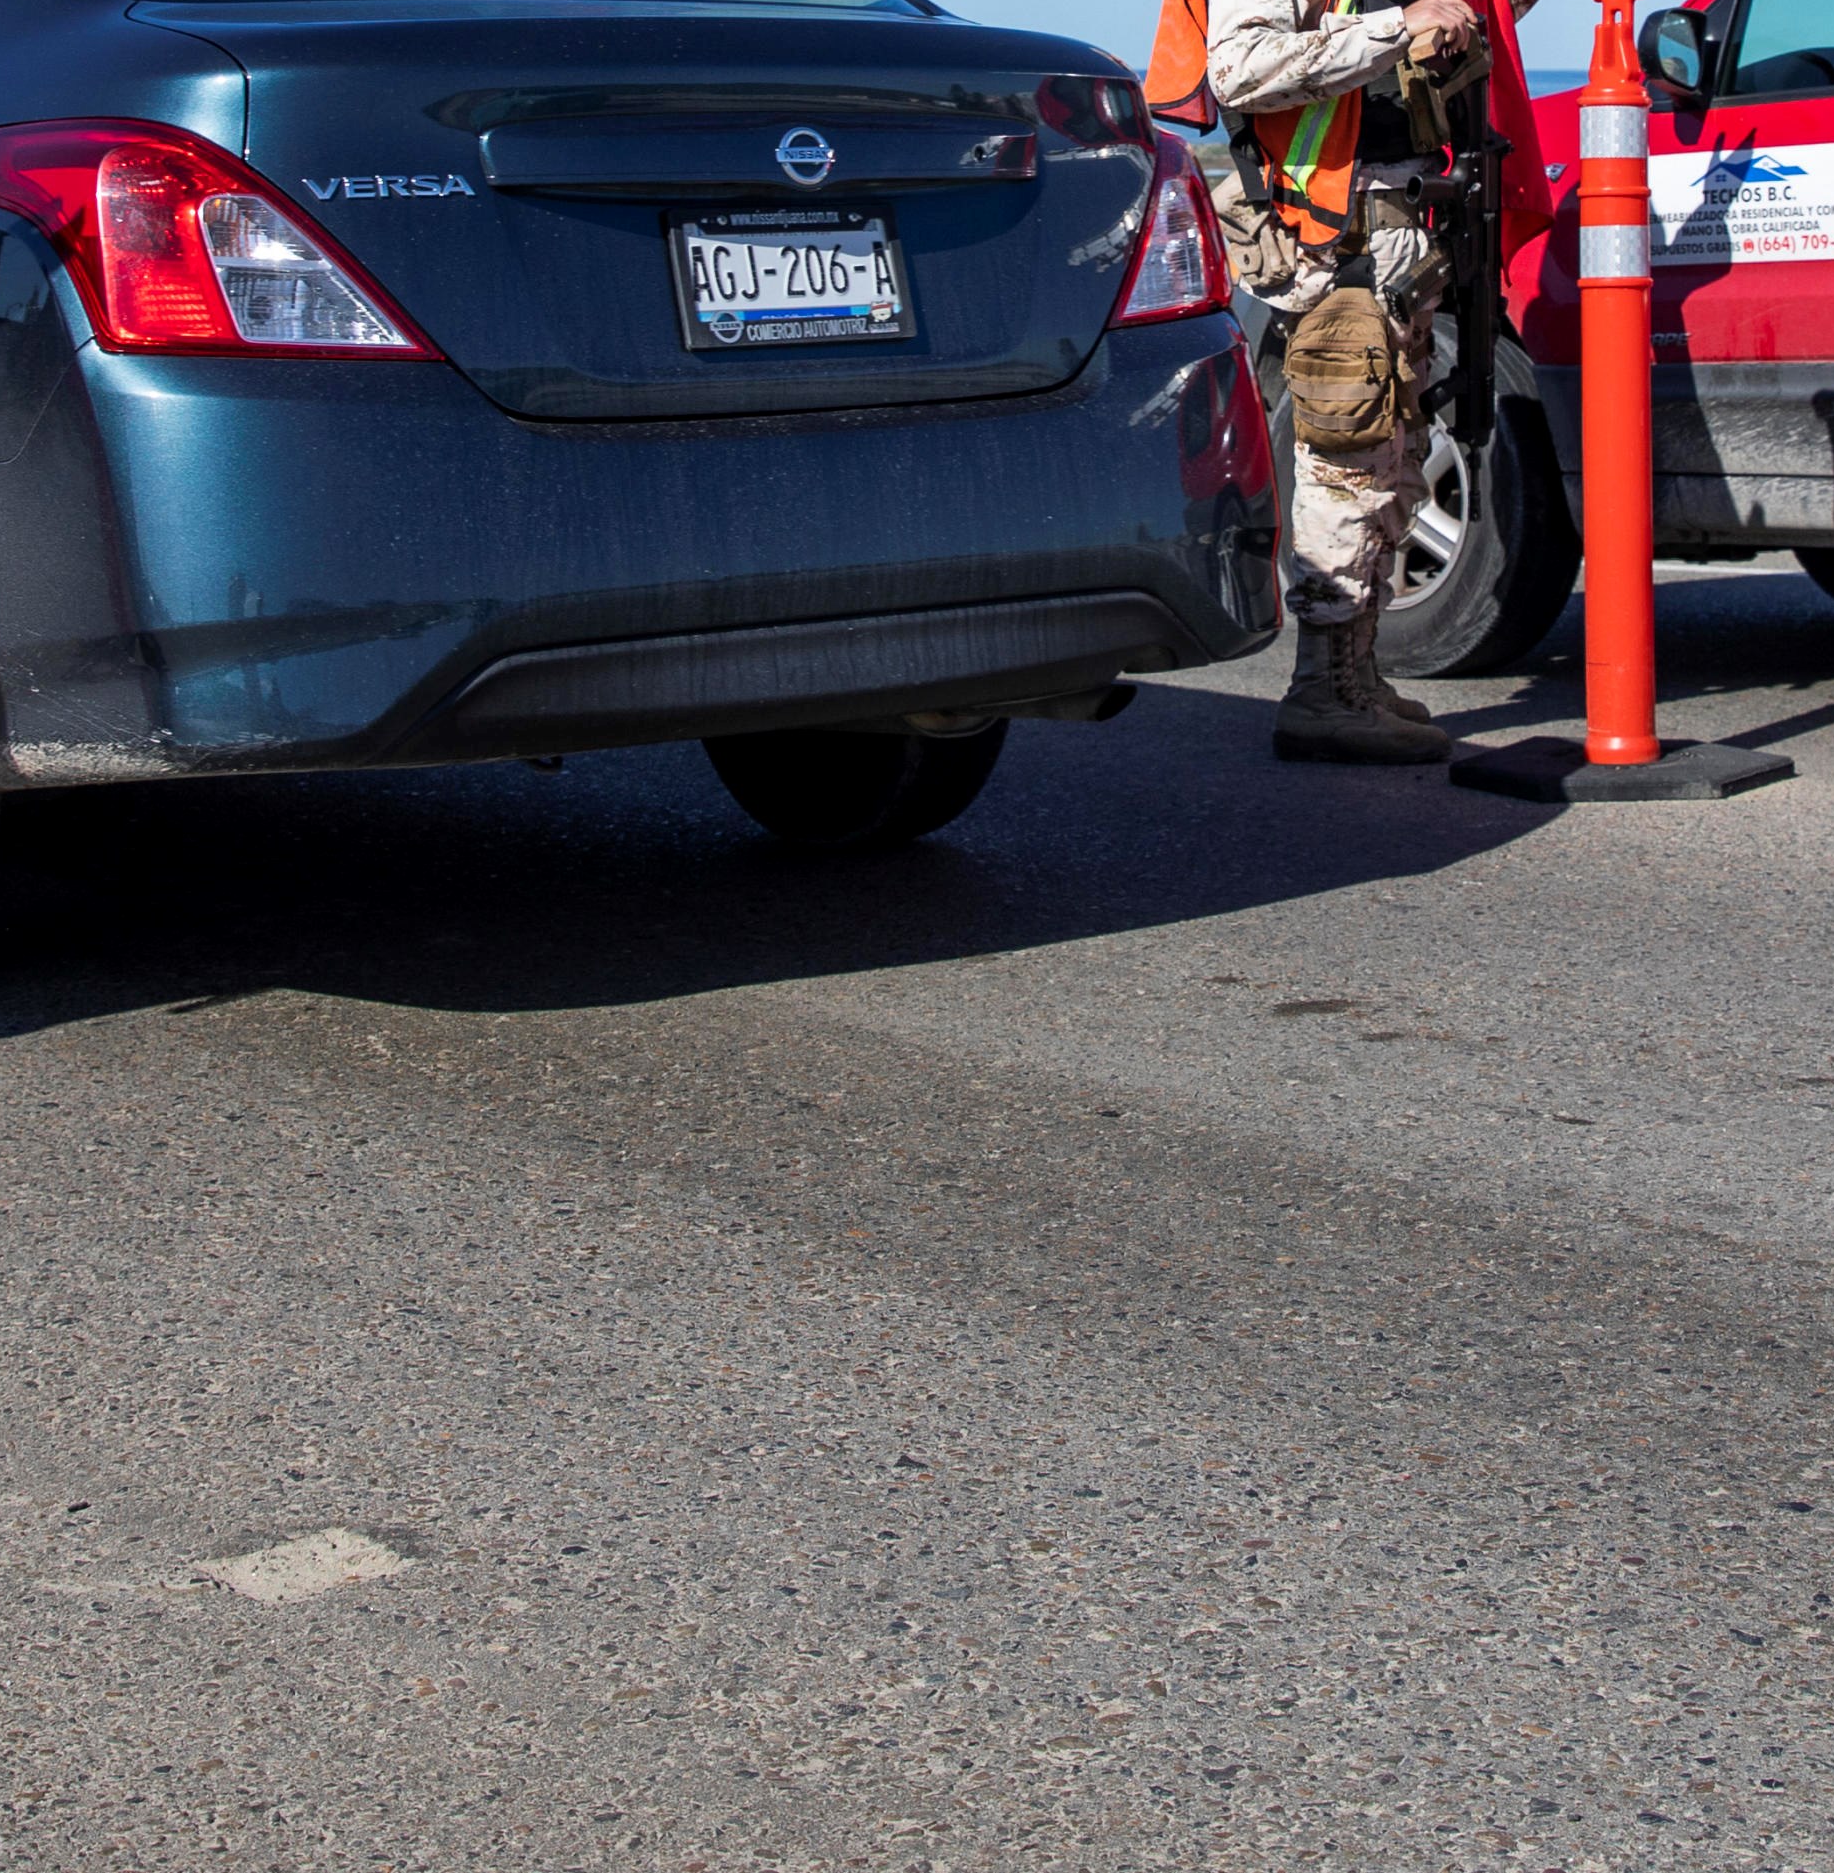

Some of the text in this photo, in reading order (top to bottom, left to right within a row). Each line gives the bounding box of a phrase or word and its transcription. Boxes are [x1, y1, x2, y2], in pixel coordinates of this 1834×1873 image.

[301, 174, 477, 201] VERSA
[1702, 185, 1797, 205] TECHOS B.C.
[1740, 206, 1805, 220] RESIDENCIAL
[1806, 206, 1814, 217] Y
[1682, 219, 1820, 237] MANO DE OBRA CALIFICADA
[1707, 239, 1741, 253] GRATIS
[1757, 233, 1797, 255] (664)
[690, 240, 897, 303] AGJ-206-A
[746, 322, 803, 342] COMERCIO
